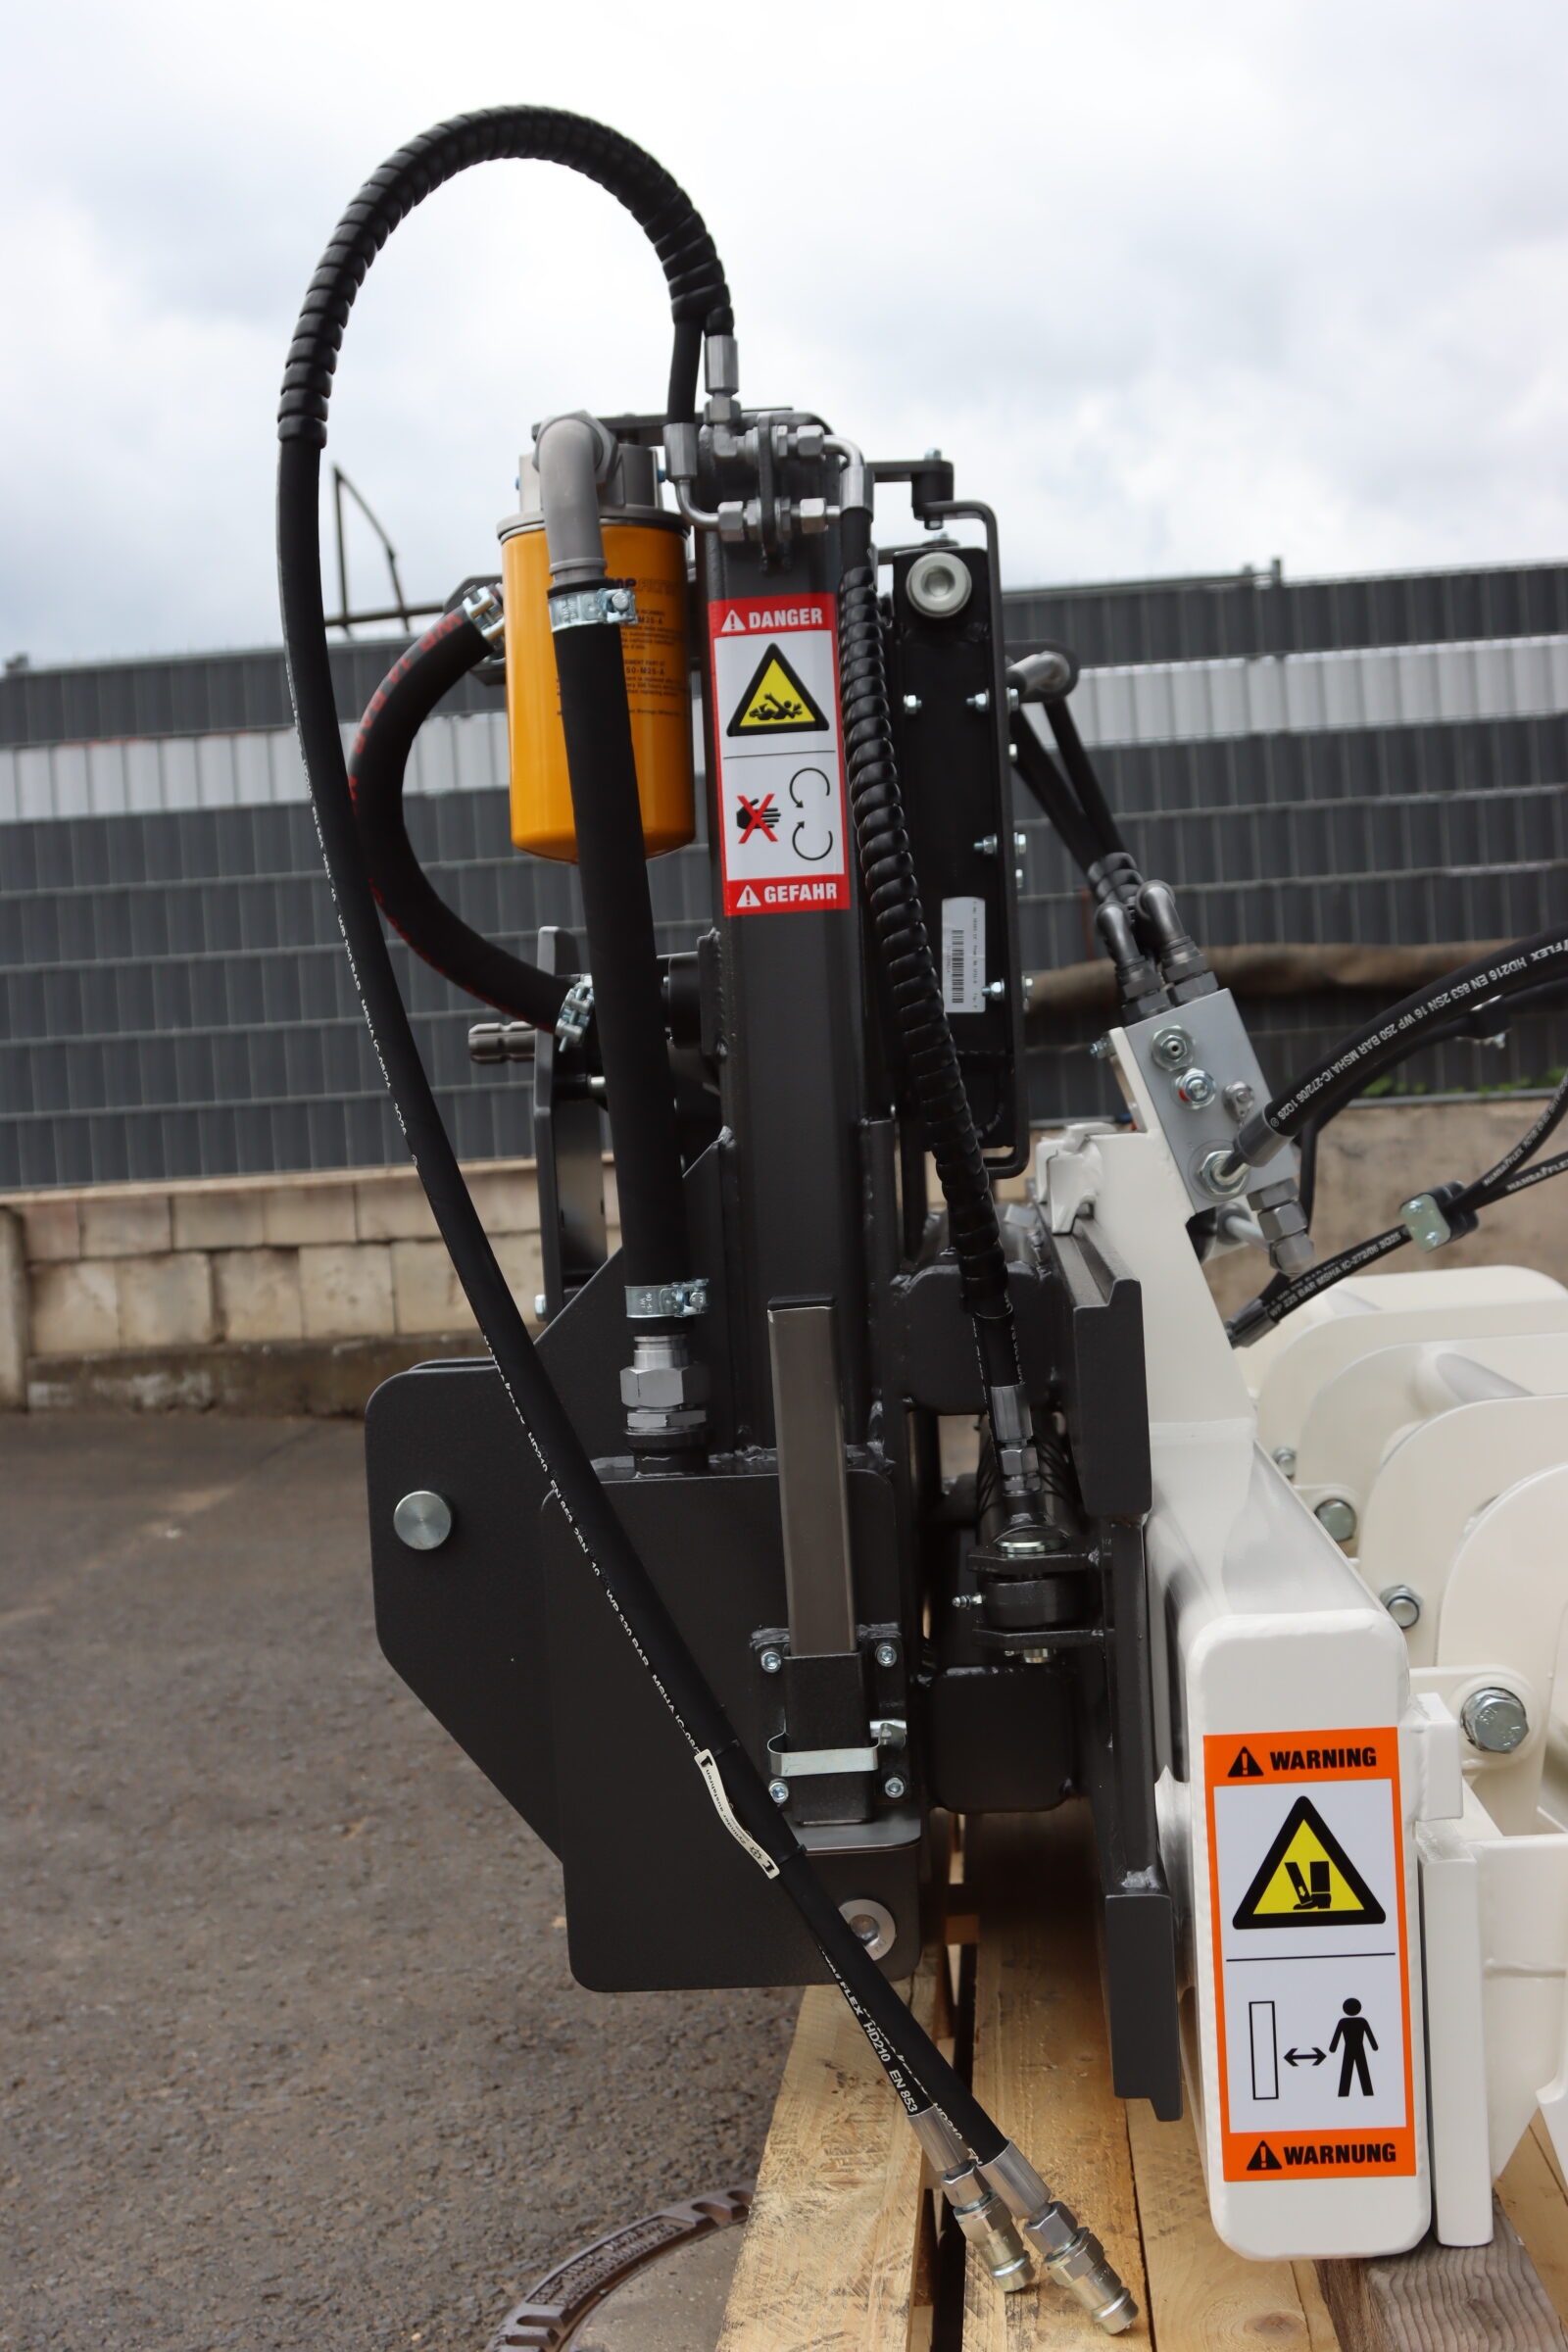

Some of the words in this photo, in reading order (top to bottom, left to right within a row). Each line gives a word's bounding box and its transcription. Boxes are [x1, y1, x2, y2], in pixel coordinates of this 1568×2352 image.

[749, 608, 823, 629] DANGER
[764, 882, 837, 904] GEFAHR
[1489, 956, 1528, 981] HD216
[1471, 973, 1489, 990] EN
[1427, 992, 1451, 1011] 2SN
[1451, 984, 1471, 1000] 853
[1414, 1005, 1428, 1019] 16
[1381, 1024, 1398, 1041] 250
[1398, 1015, 1416, 1030] WP
[1357, 1034, 1382, 1054] BAR
[1331, 1052, 1361, 1074] MSHA
[1270, 1746, 1377, 1770] WARNING
[863, 2021, 891, 2062] HD210
[889, 2069, 906, 2088] EN
[900, 2089, 918, 2113] 853
[1284, 2142, 1397, 2166] WARNUNG
